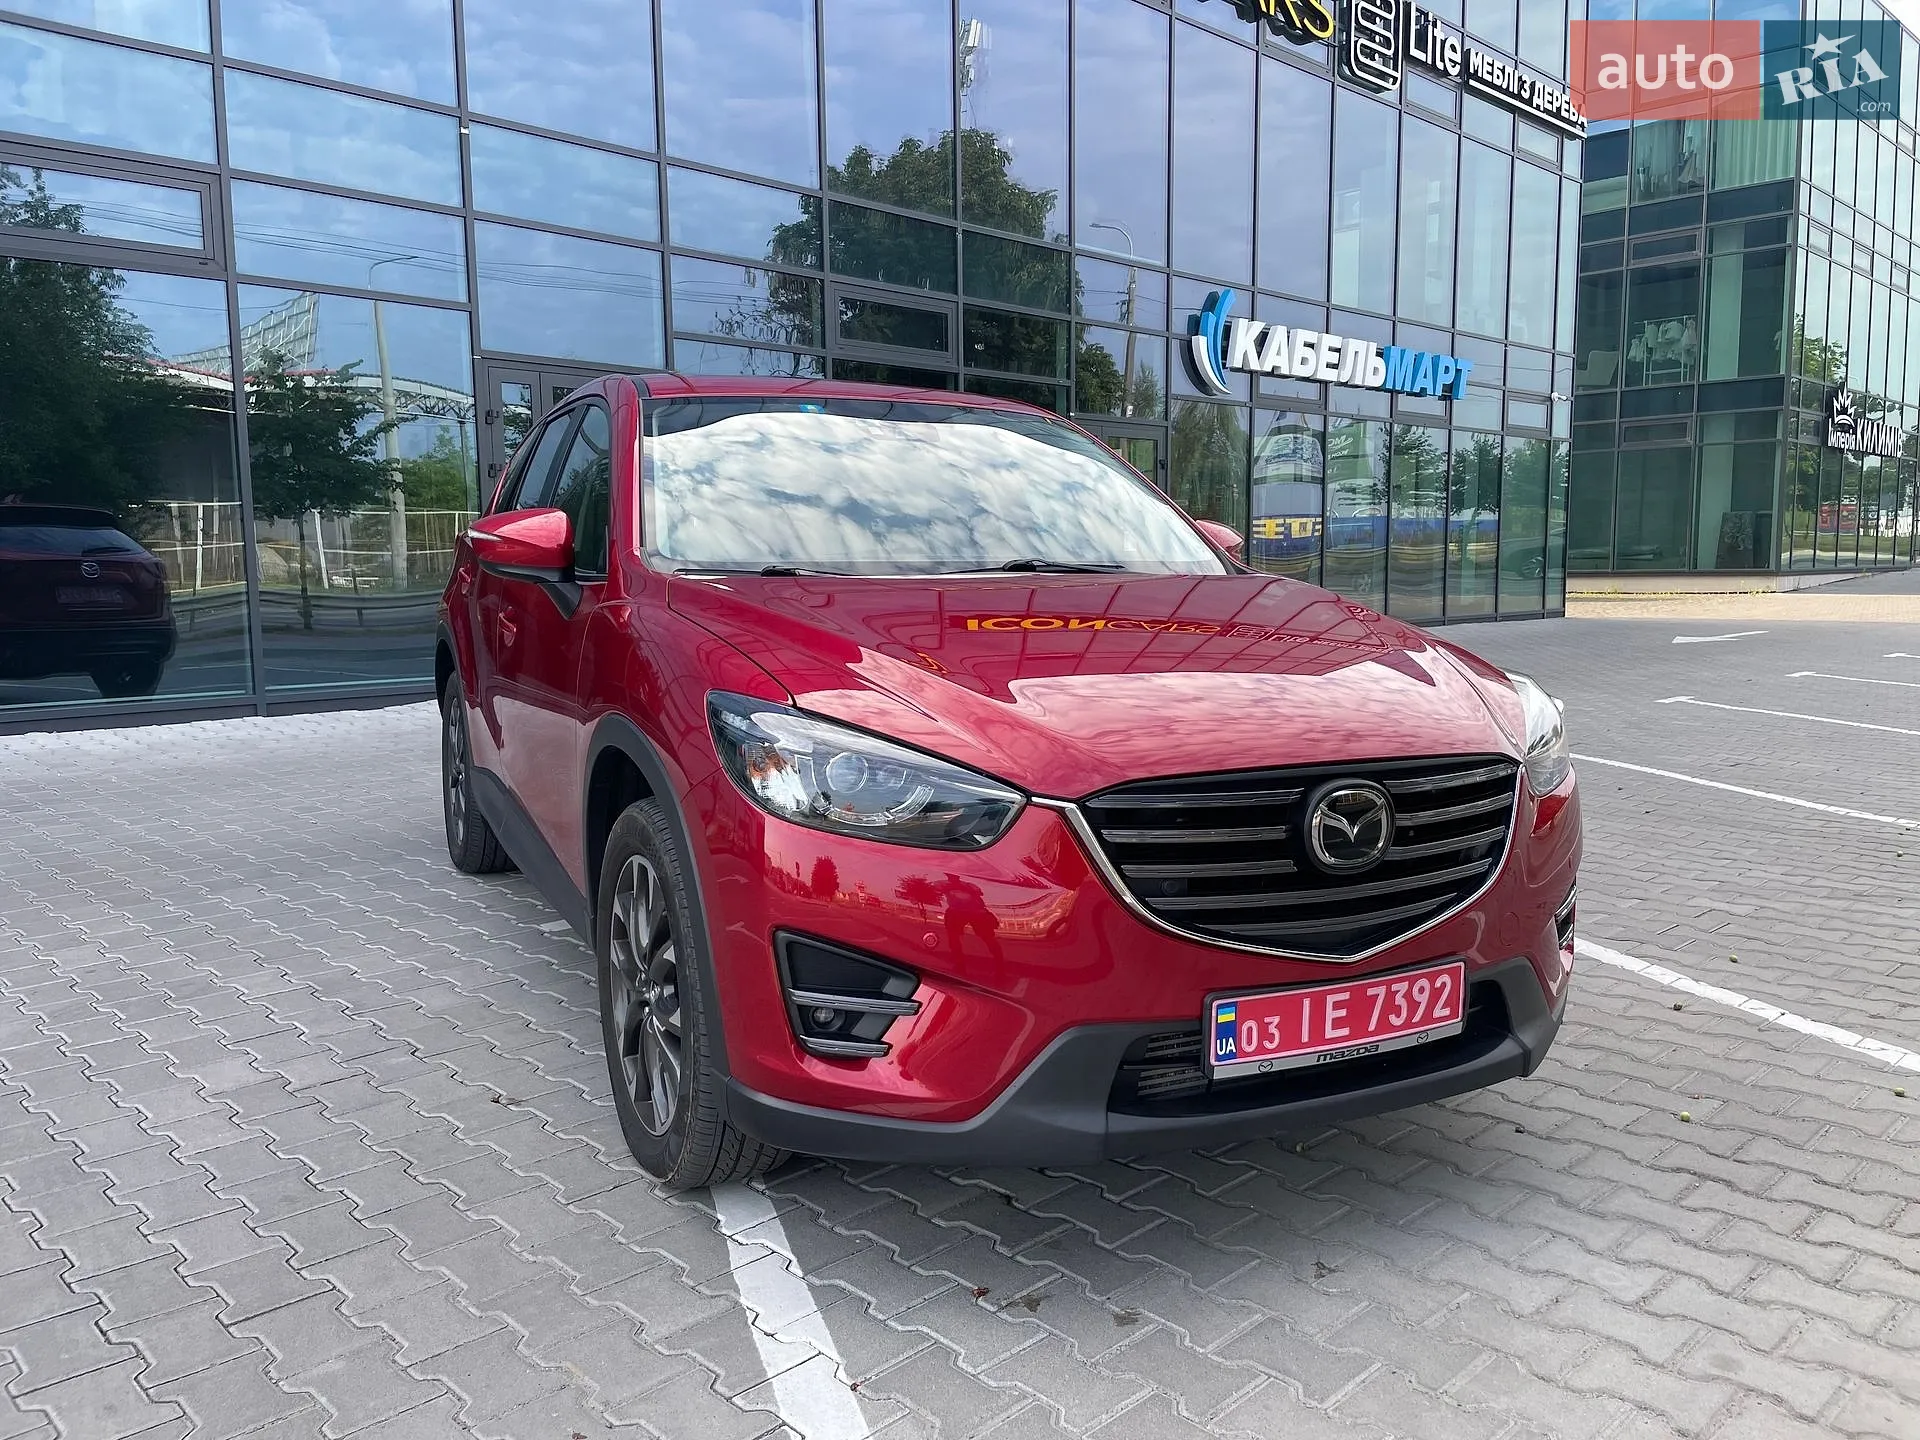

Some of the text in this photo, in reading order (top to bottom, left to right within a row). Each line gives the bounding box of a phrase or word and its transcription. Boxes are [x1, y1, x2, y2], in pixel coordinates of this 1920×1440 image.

[1409, 1, 1461, 76] Lite
[1469, 48, 1519, 95] МЕБЛІ
[1533, 80, 1587, 129] ДЕРЕВА
[1226, 317, 1475, 400] КАБЕЛЬМАРТ
[1856, 418, 1903, 458] КИЛИМІВ
[1217, 1037, 1236, 1056] UA
[1241, 1016, 1281, 1052] 03
[1366, 974, 1452, 1032] 7392
